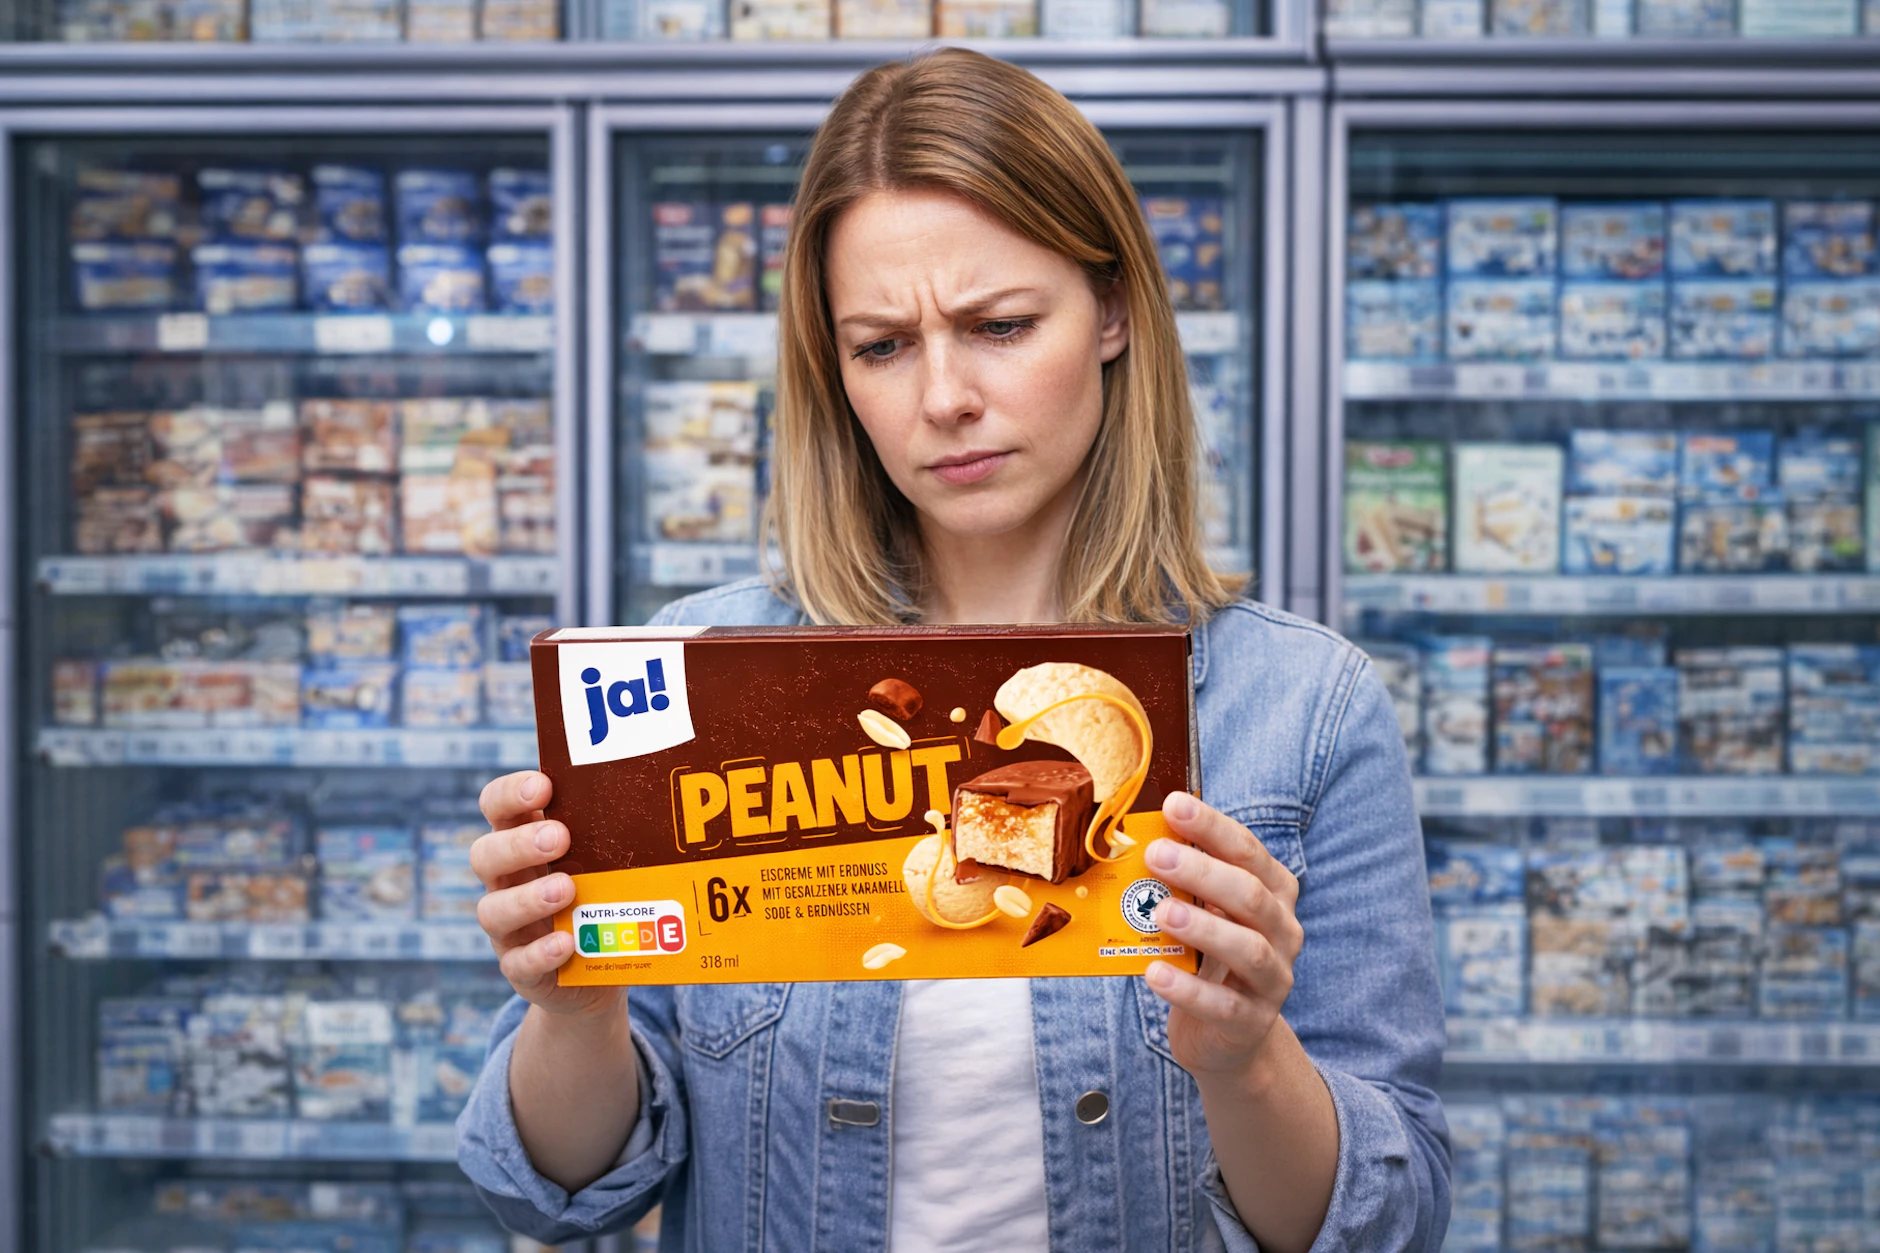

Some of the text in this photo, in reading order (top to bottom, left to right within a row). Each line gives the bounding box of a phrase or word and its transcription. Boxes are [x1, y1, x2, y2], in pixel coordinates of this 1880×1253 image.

[580, 657, 670, 746] ja!
[678, 744, 962, 844] PEANUT
[760, 862, 888, 882] EISCREME MIT ERDNUSS
[707, 877, 751, 922] 6x
[762, 887, 781, 901] MIT
[851, 880, 906, 895] KARAMELL
[581, 907, 655, 918] NUTRI-SCORE
[795, 906, 804, 918] &
[583, 922, 680, 947] A B C D E
[700, 954, 739, 968] 318 ml
